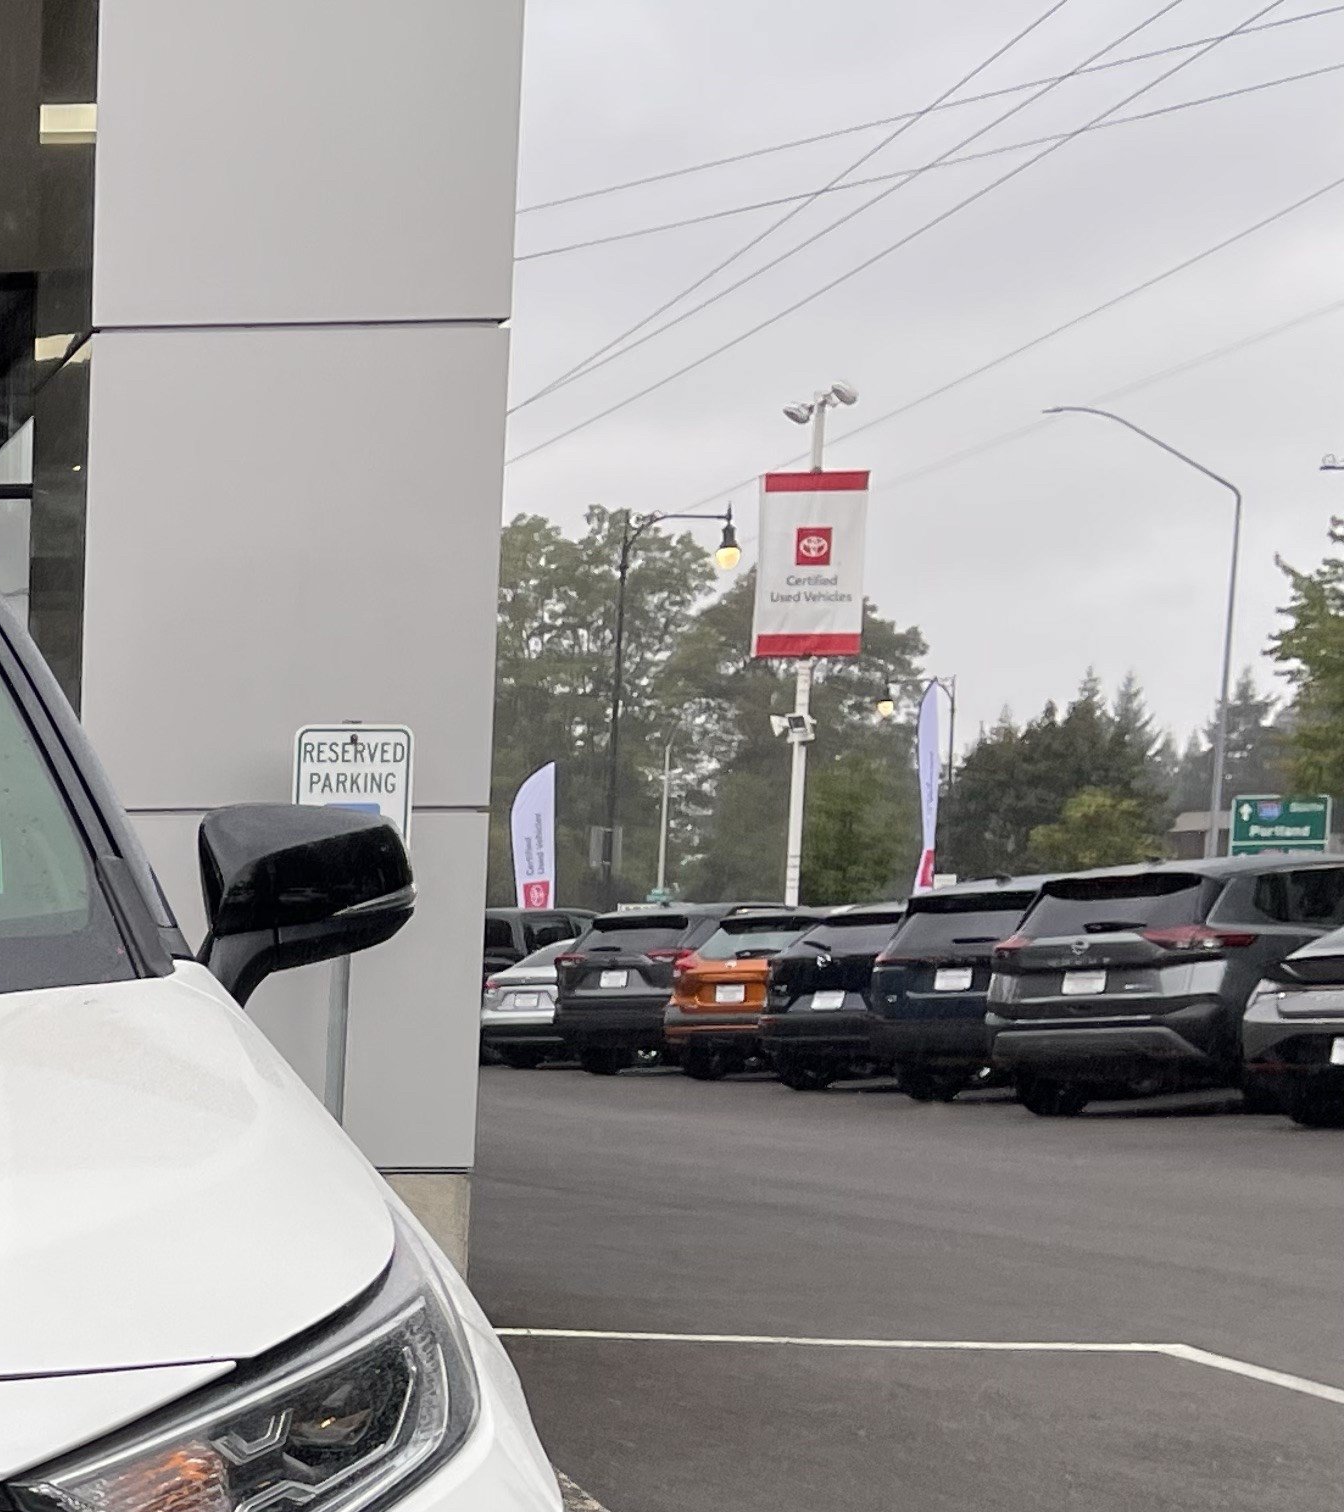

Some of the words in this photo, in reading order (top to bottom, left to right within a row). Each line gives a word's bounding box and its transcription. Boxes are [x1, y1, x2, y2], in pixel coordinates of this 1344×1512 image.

[785, 574, 838, 586] Certified
[770, 592, 801, 602] Used
[804, 591, 853, 602] Vehicles
[303, 742, 405, 763] RESERVED
[309, 772, 397, 794] PARKING
